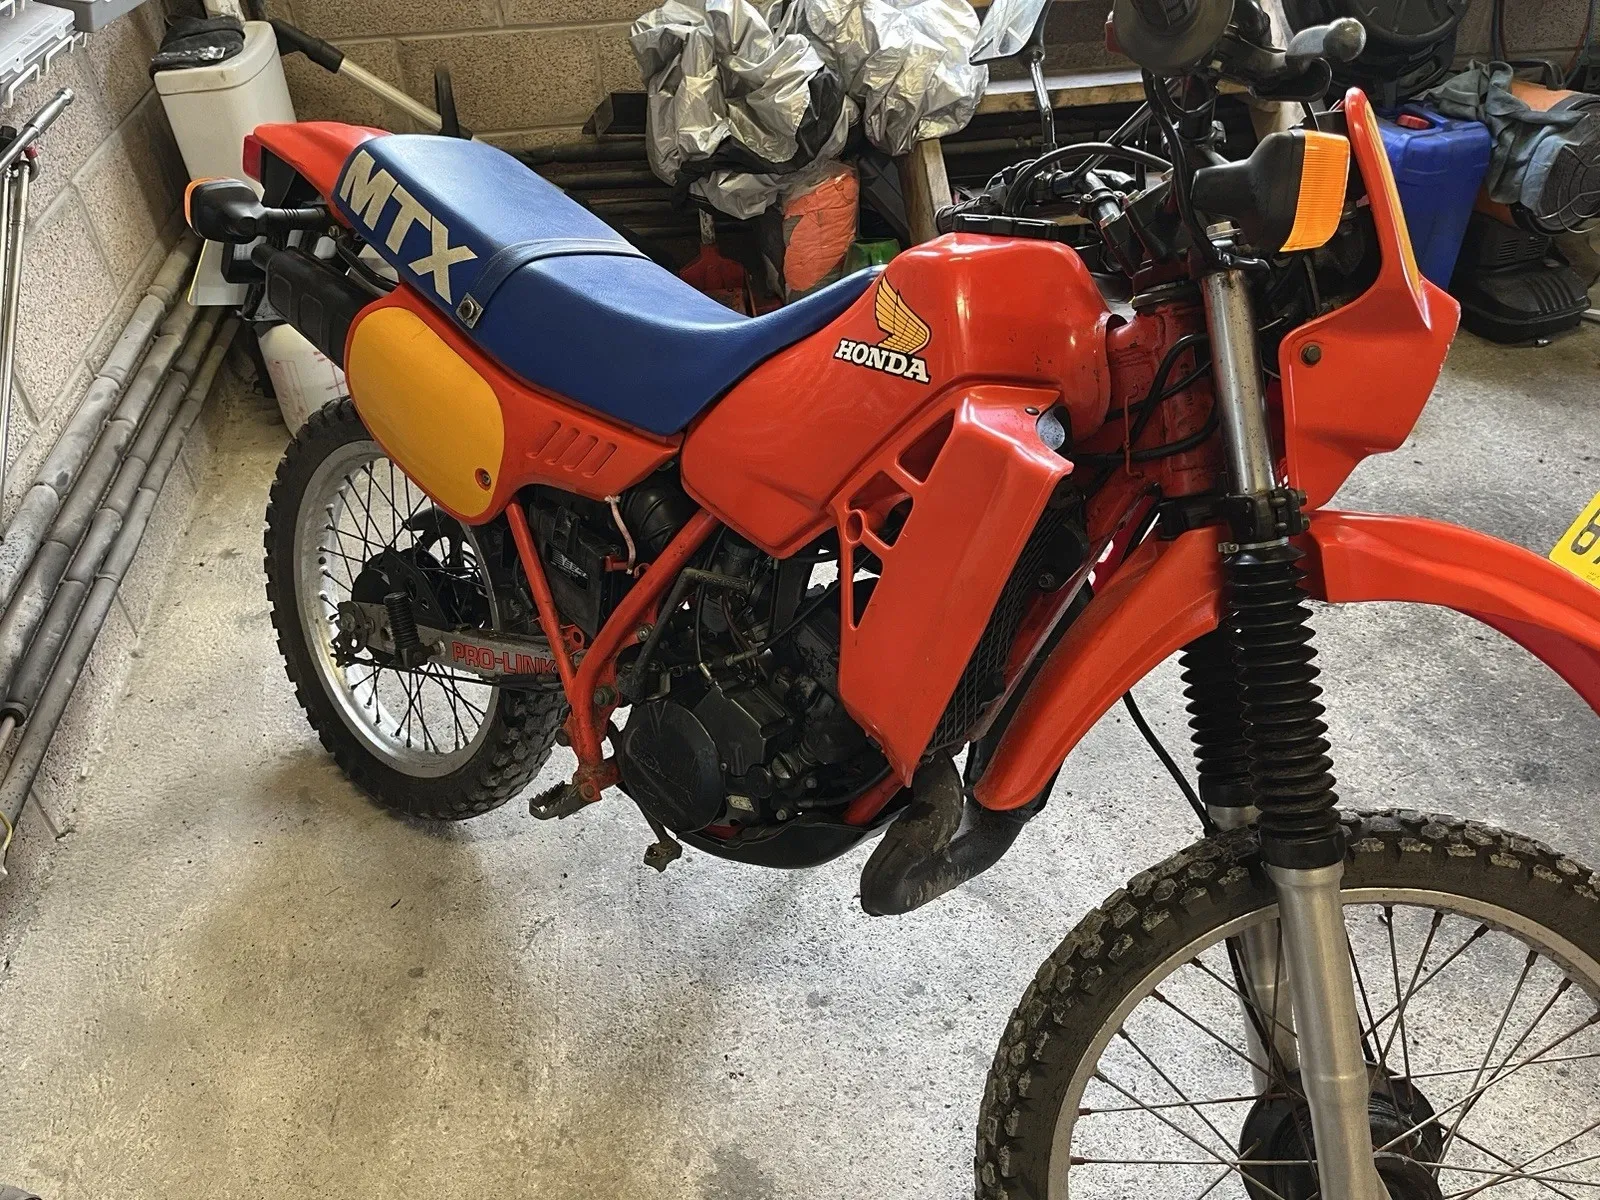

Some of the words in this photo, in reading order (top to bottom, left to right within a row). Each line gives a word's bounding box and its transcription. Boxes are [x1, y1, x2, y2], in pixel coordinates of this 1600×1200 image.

[339, 149, 478, 305] MTX
[834, 339, 930, 383] HONDA
[451, 641, 556, 674] PRO-LINK
